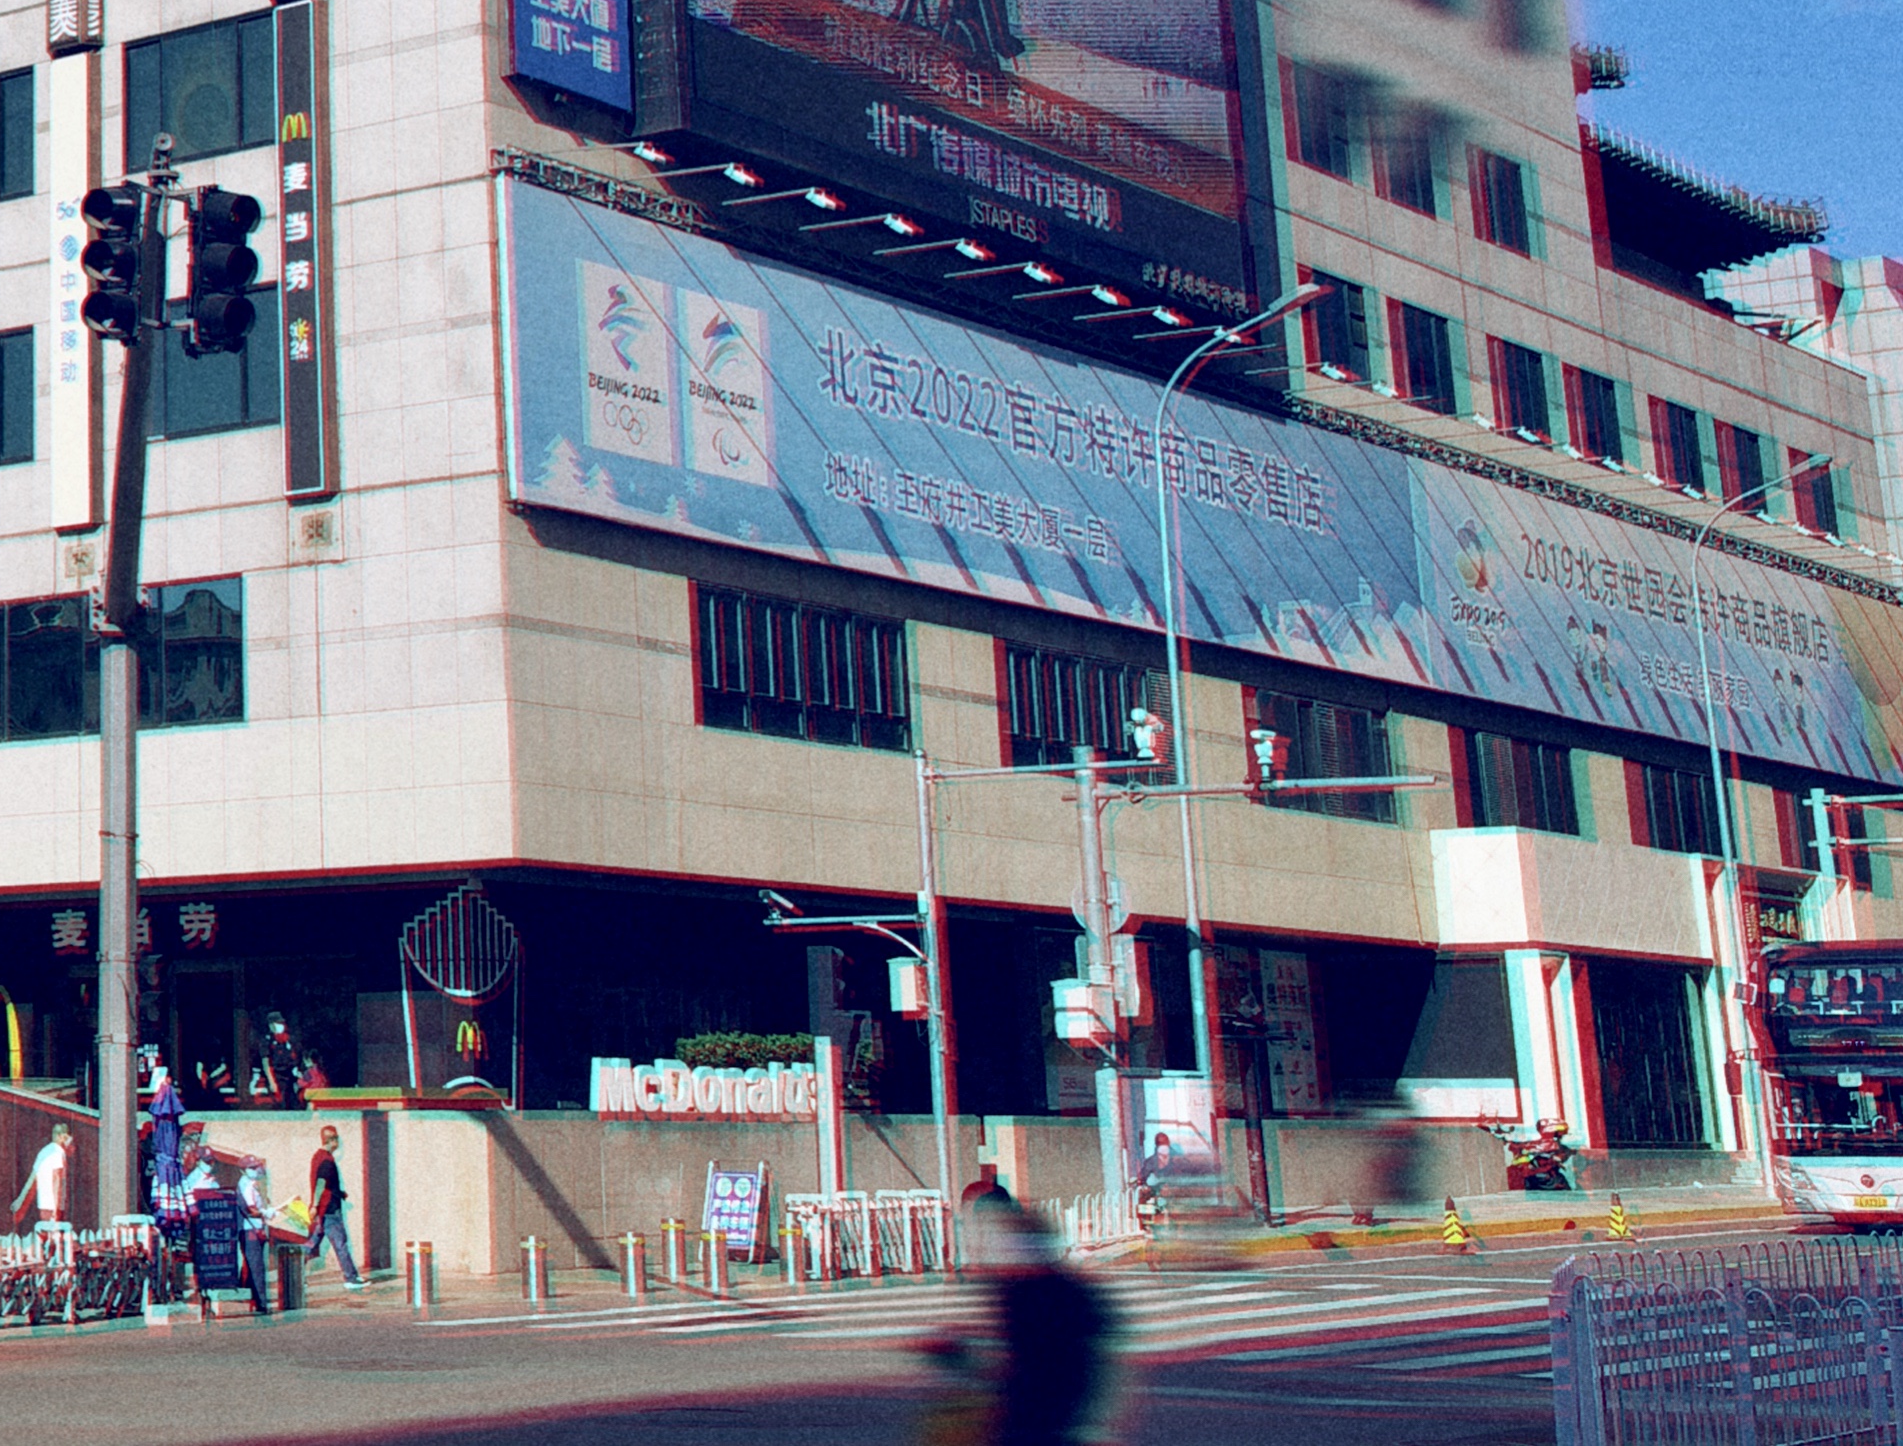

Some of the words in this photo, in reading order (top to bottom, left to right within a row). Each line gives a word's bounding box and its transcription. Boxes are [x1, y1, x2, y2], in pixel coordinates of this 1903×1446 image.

[283, 161, 312, 292] 麦当劳
[972, 199, 1040, 245] STAPLES
[587, 371, 629, 400] BEIJING
[631, 384, 663, 405] 2022
[688, 380, 727, 404] BEIJING
[729, 391, 758, 411] 2022
[820, 325, 1326, 535] 北京2022官方特许商品零售店
